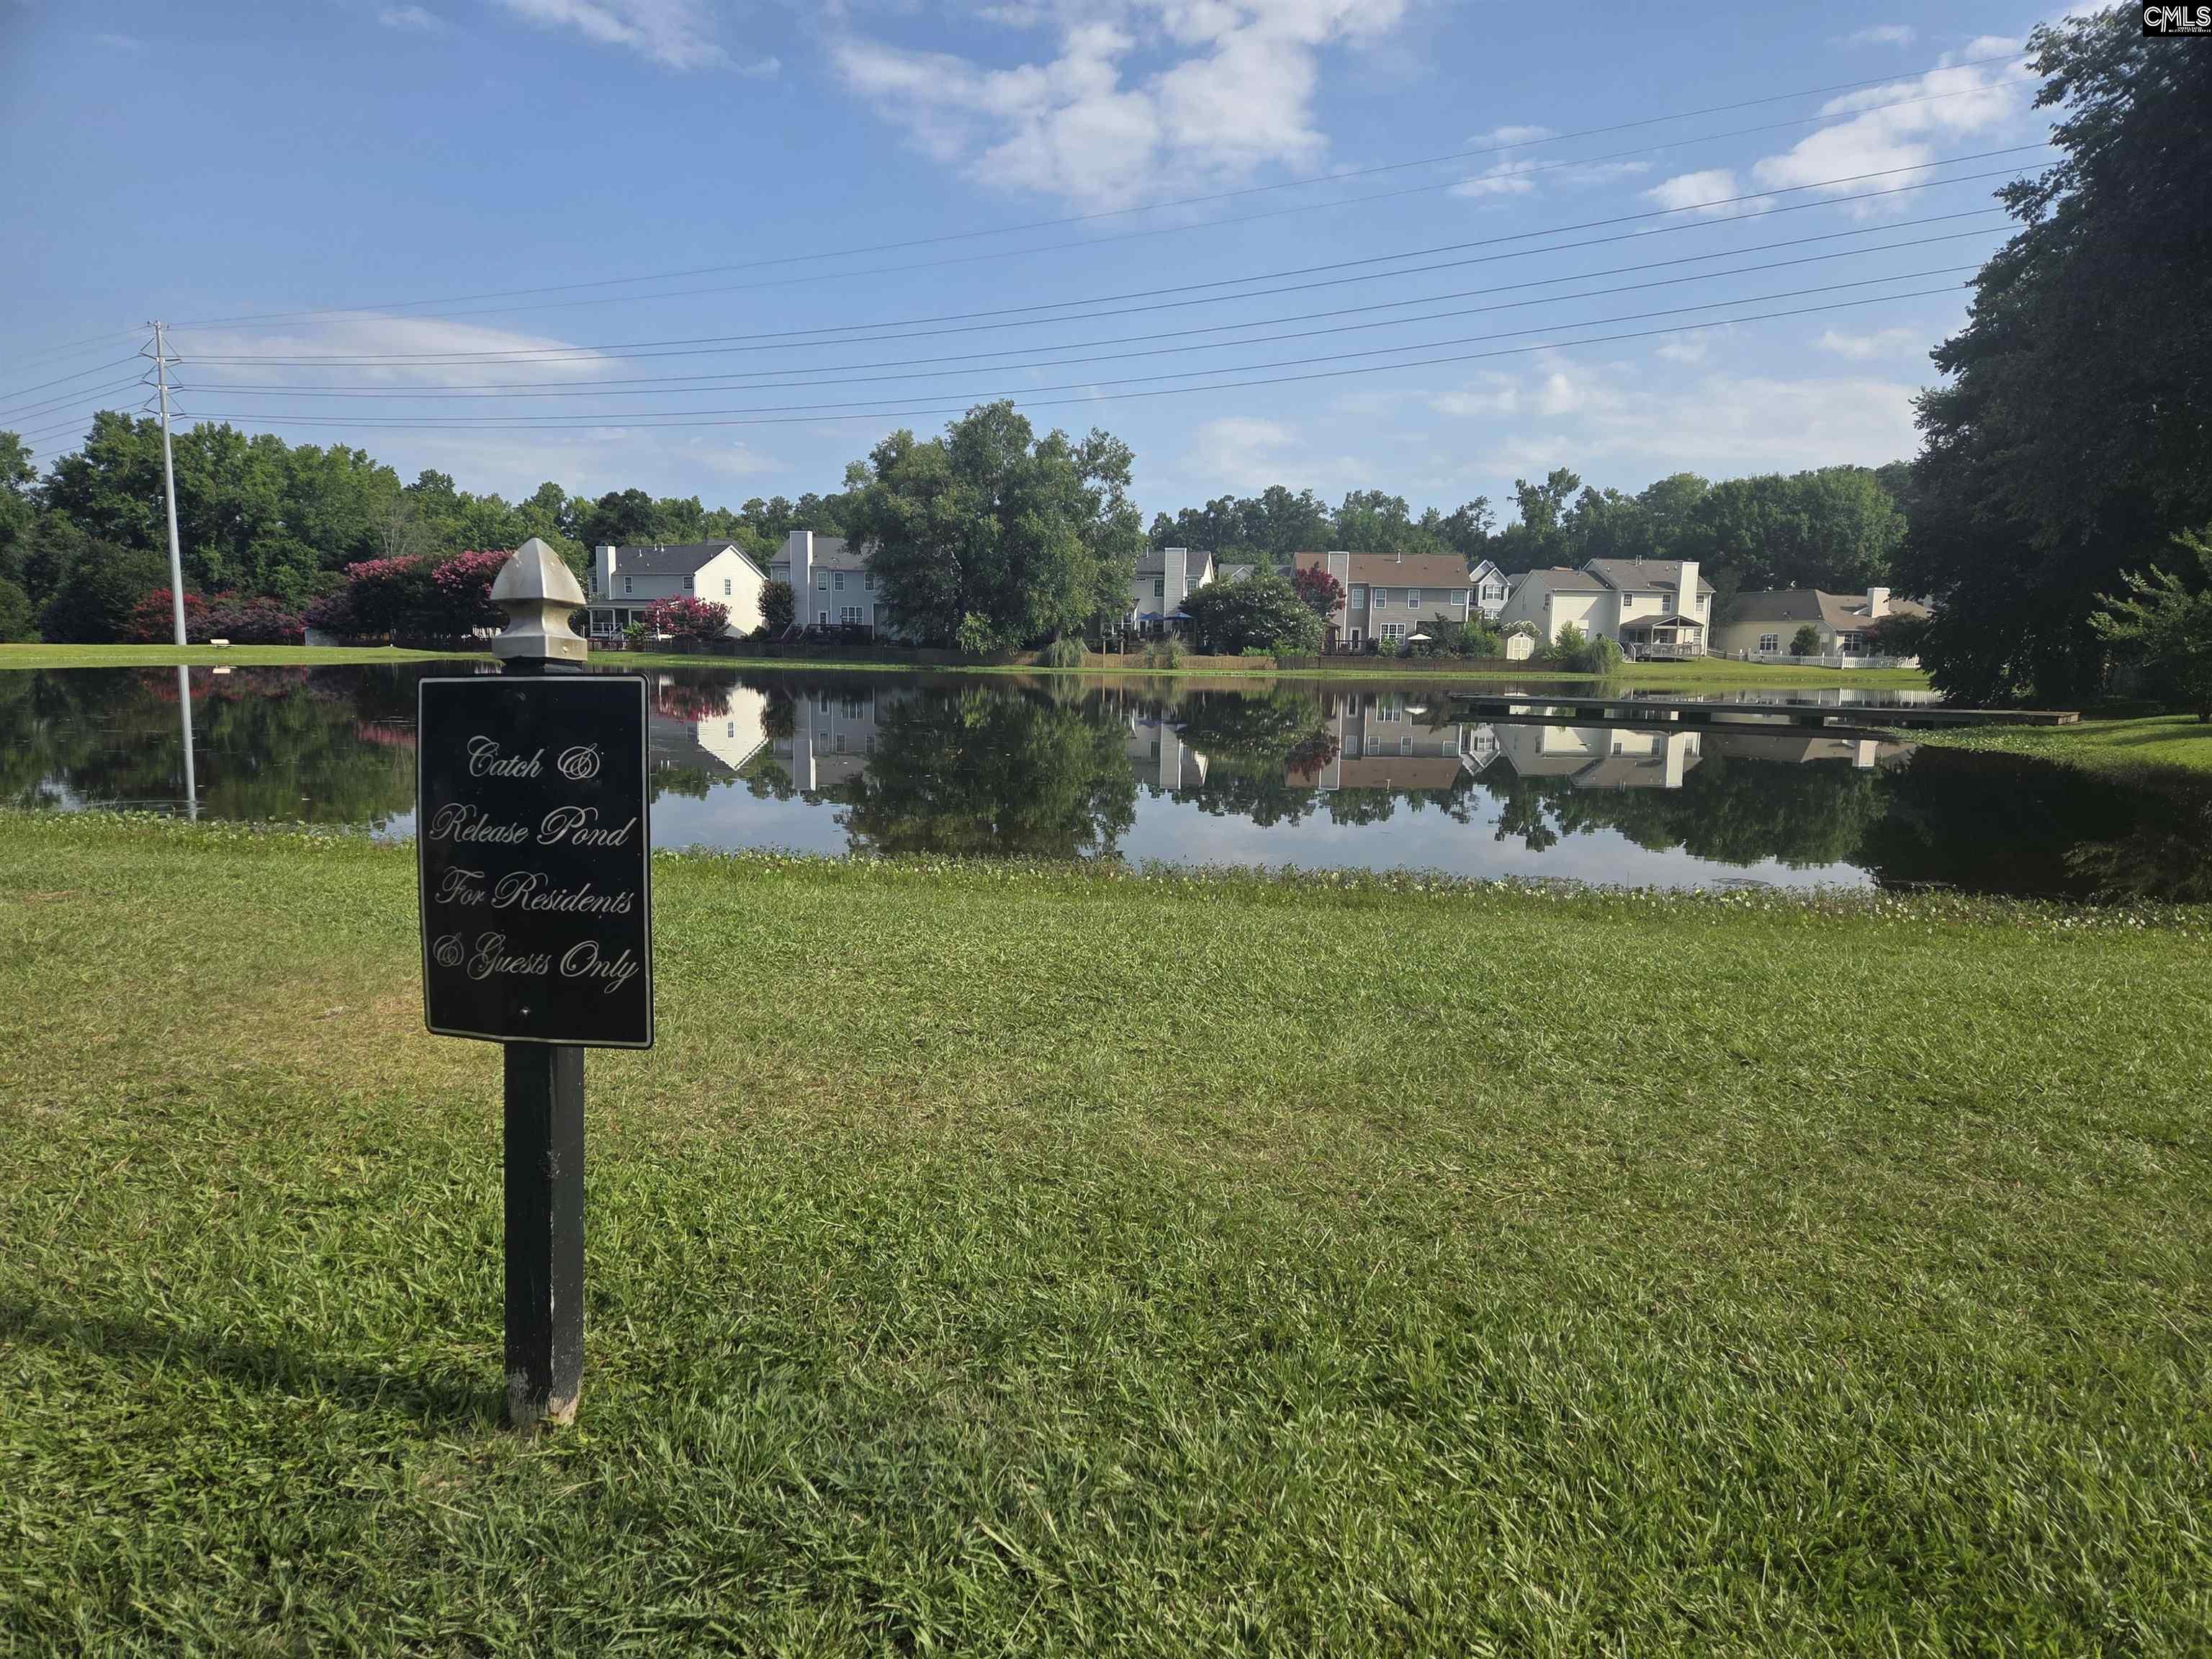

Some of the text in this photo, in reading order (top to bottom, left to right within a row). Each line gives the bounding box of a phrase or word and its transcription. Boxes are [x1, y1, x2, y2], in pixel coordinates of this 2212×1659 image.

[467, 735, 601, 780] Catch &
[429, 803, 637, 846] Release Pond
[435, 866, 634, 914] For Residents
[433, 932, 640, 994] & Guests Only
